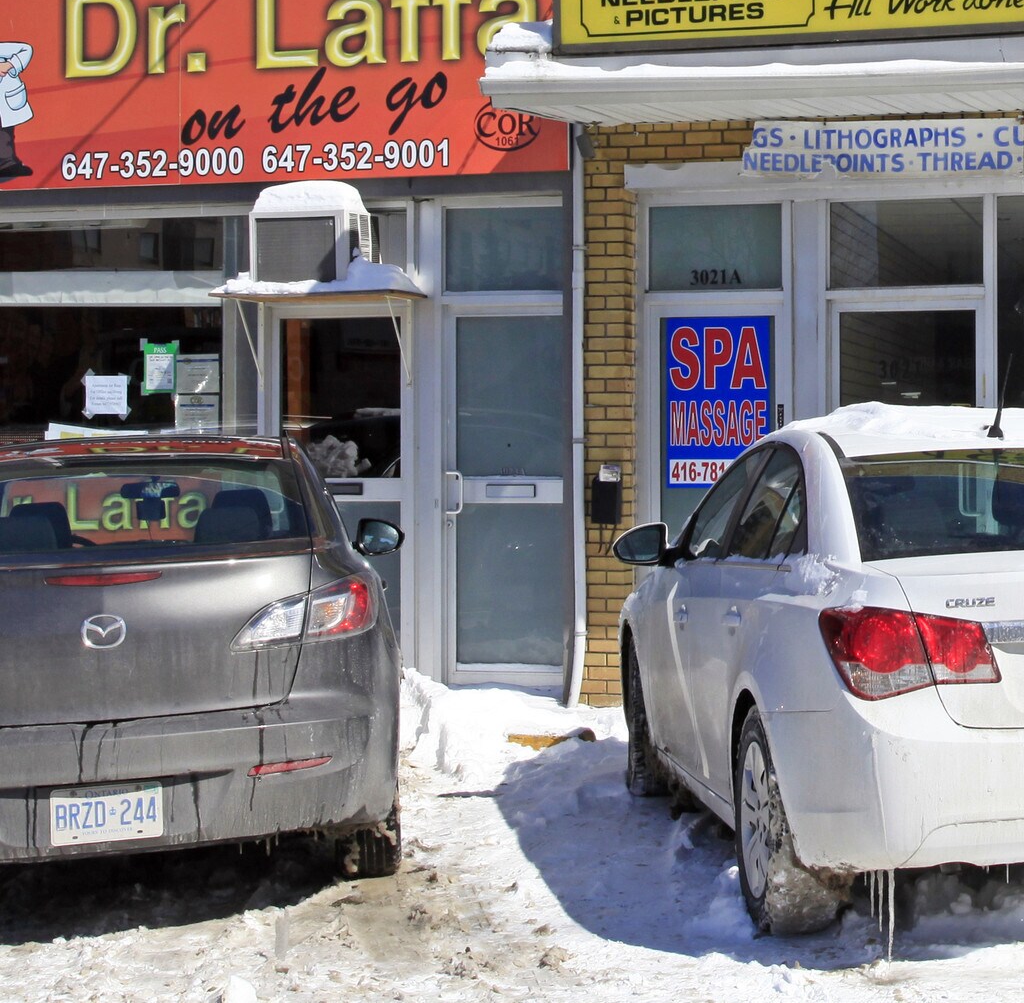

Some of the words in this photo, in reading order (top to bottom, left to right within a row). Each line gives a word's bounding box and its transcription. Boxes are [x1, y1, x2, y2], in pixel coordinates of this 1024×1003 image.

[626, 2, 764, 27] PICTURES
[181, 103, 245, 146] on
[268, 66, 360, 133] the
[386, 71, 448, 134] go
[477, 112, 538, 137] COR
[495, 136, 519, 146] 1061
[753, 127, 784, 148] GS
[803, 126, 966, 149] LITHOGRAPHS
[61, 146, 244, 181] 647-352-9000
[262, 139, 450, 174] 647-352-9001
[917, 150, 1013, 172] THREAD
[690, 269, 742, 285] 3021A
[669, 326, 767, 390] SPA
[670, 400, 767, 446] MASSAGE
[945, 596, 995, 609] CRUZE
[85, 788, 128, 799] ONTARIO
[55, 801, 106, 832] BRZD
[120, 796, 157, 825] 244
